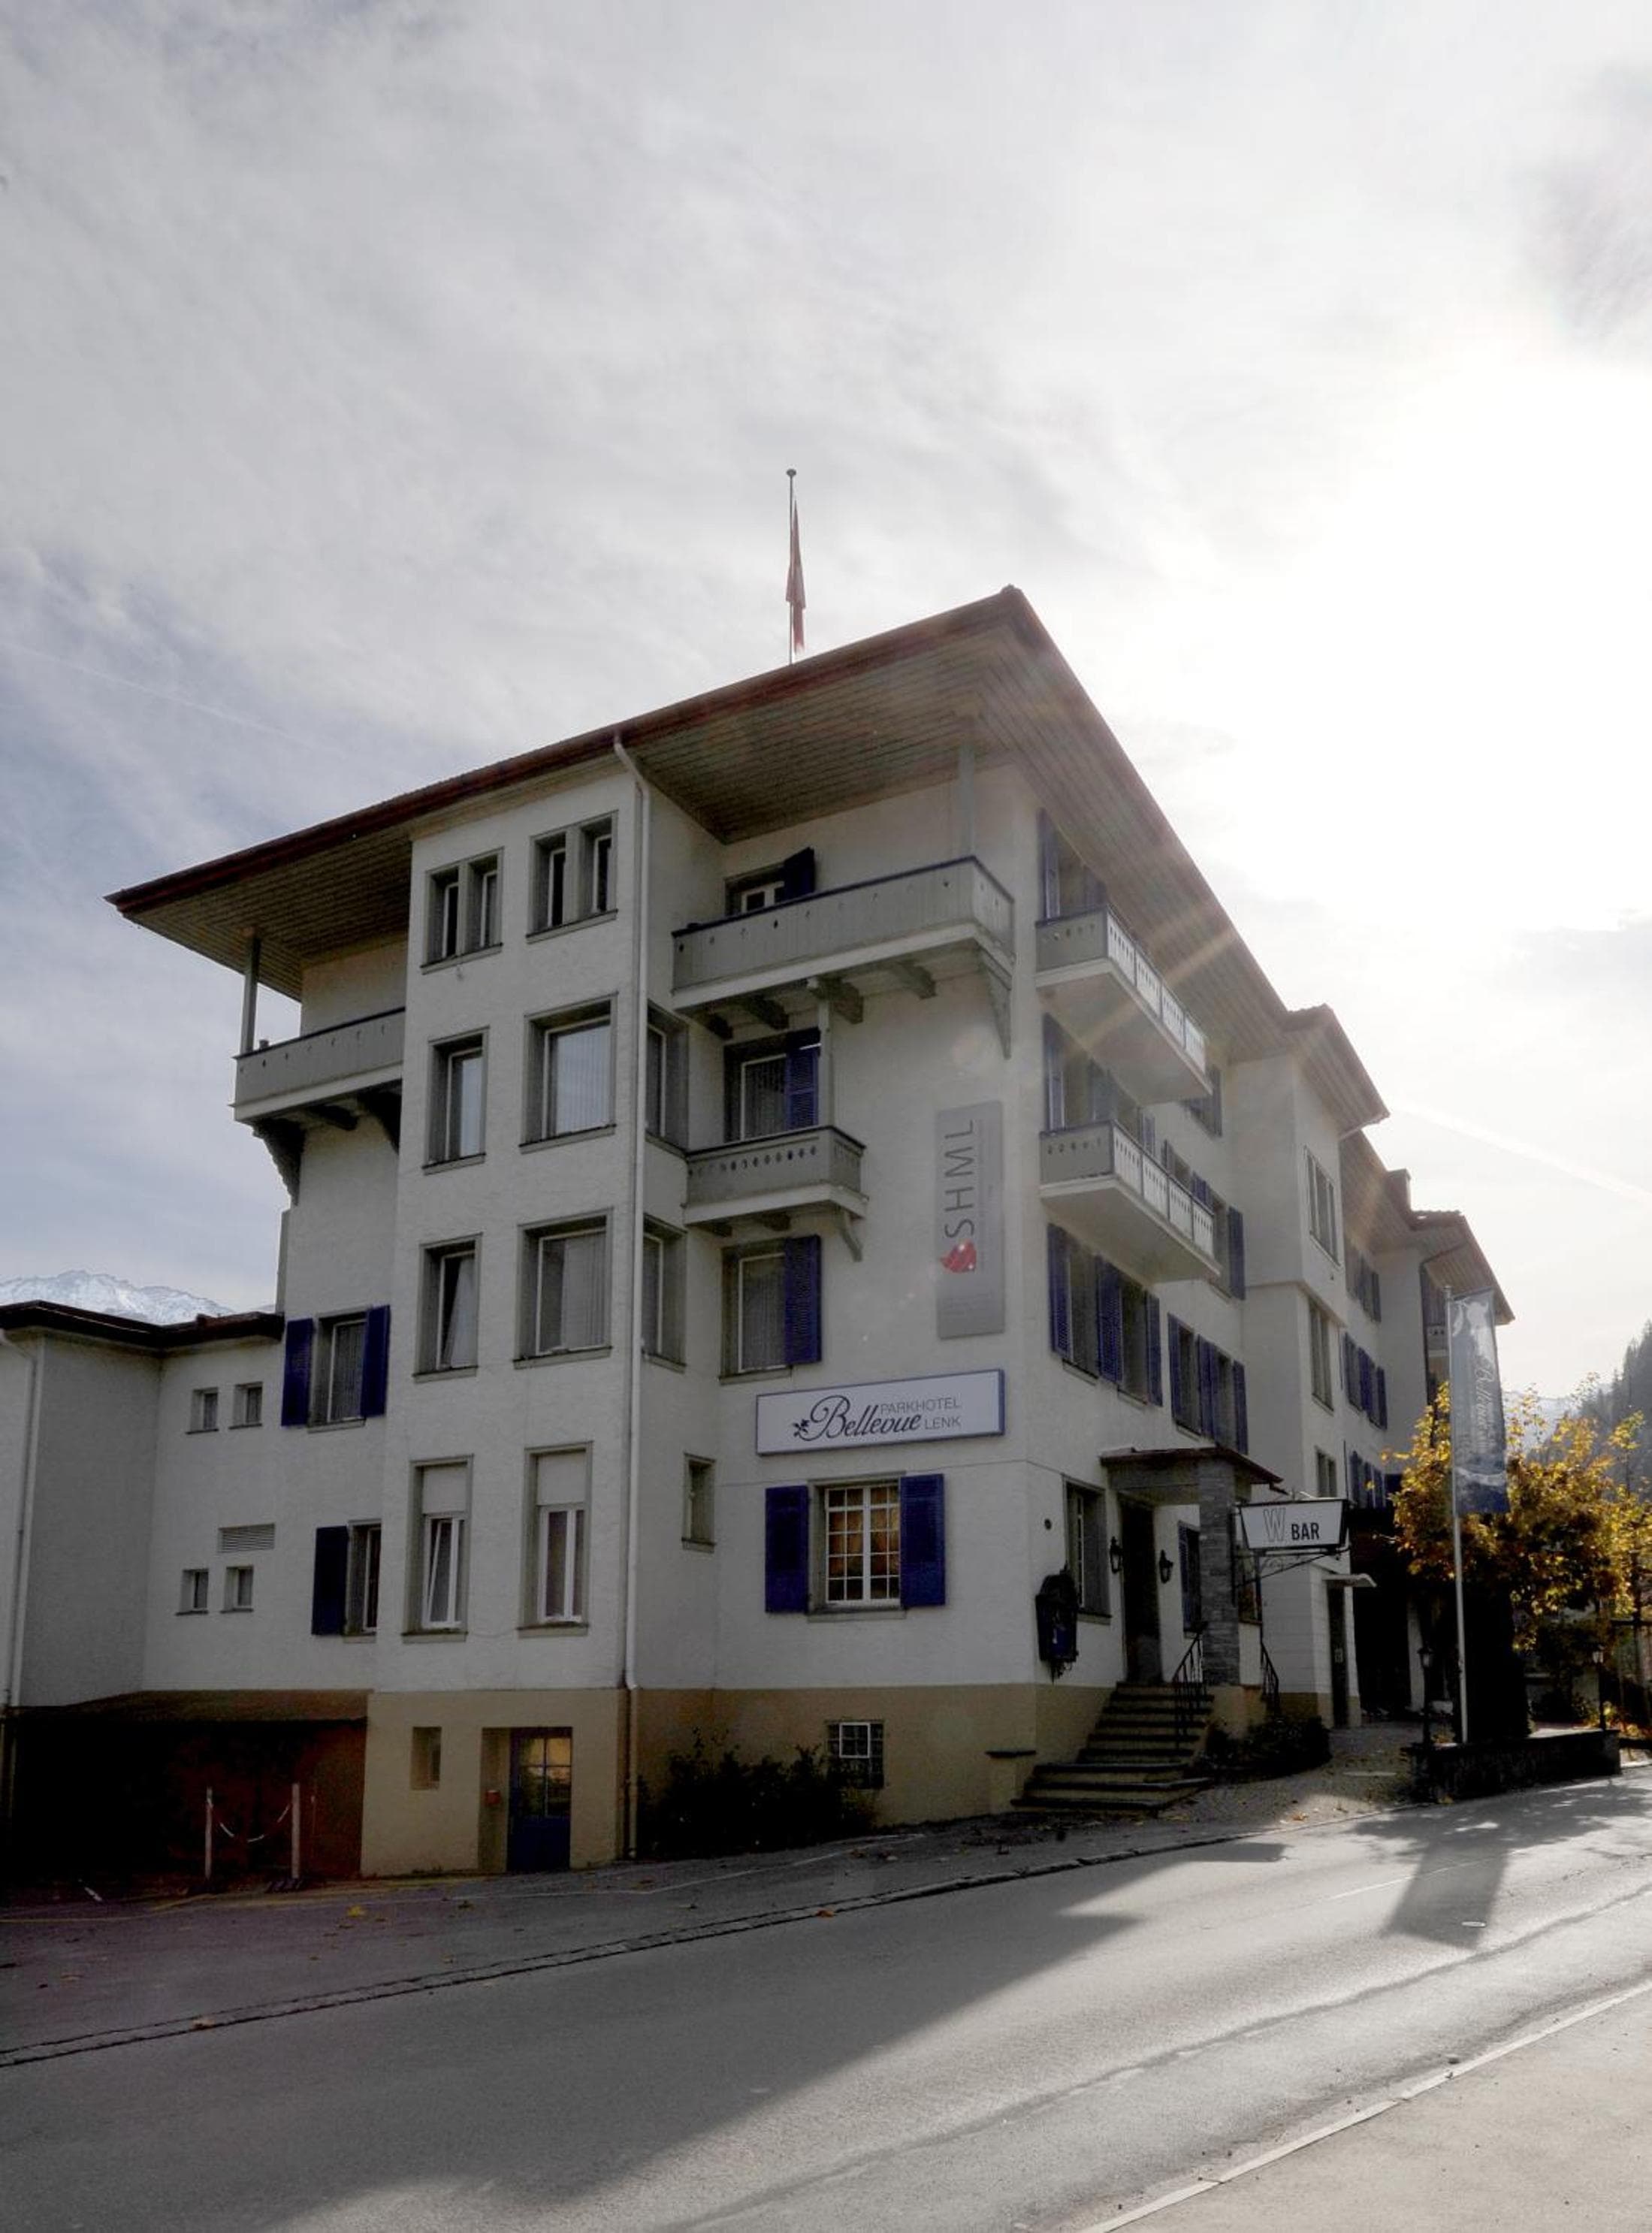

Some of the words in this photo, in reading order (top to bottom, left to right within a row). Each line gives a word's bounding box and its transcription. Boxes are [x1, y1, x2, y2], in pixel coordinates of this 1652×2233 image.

[944, 1119, 975, 1239] SHML
[797, 1394, 923, 1442] Bellevue
[879, 1397, 962, 1416] PARKHOTEL
[924, 1416, 962, 1431] LENK
[1262, 1506, 1287, 1543] W
[1291, 1521, 1320, 1541] BAR
